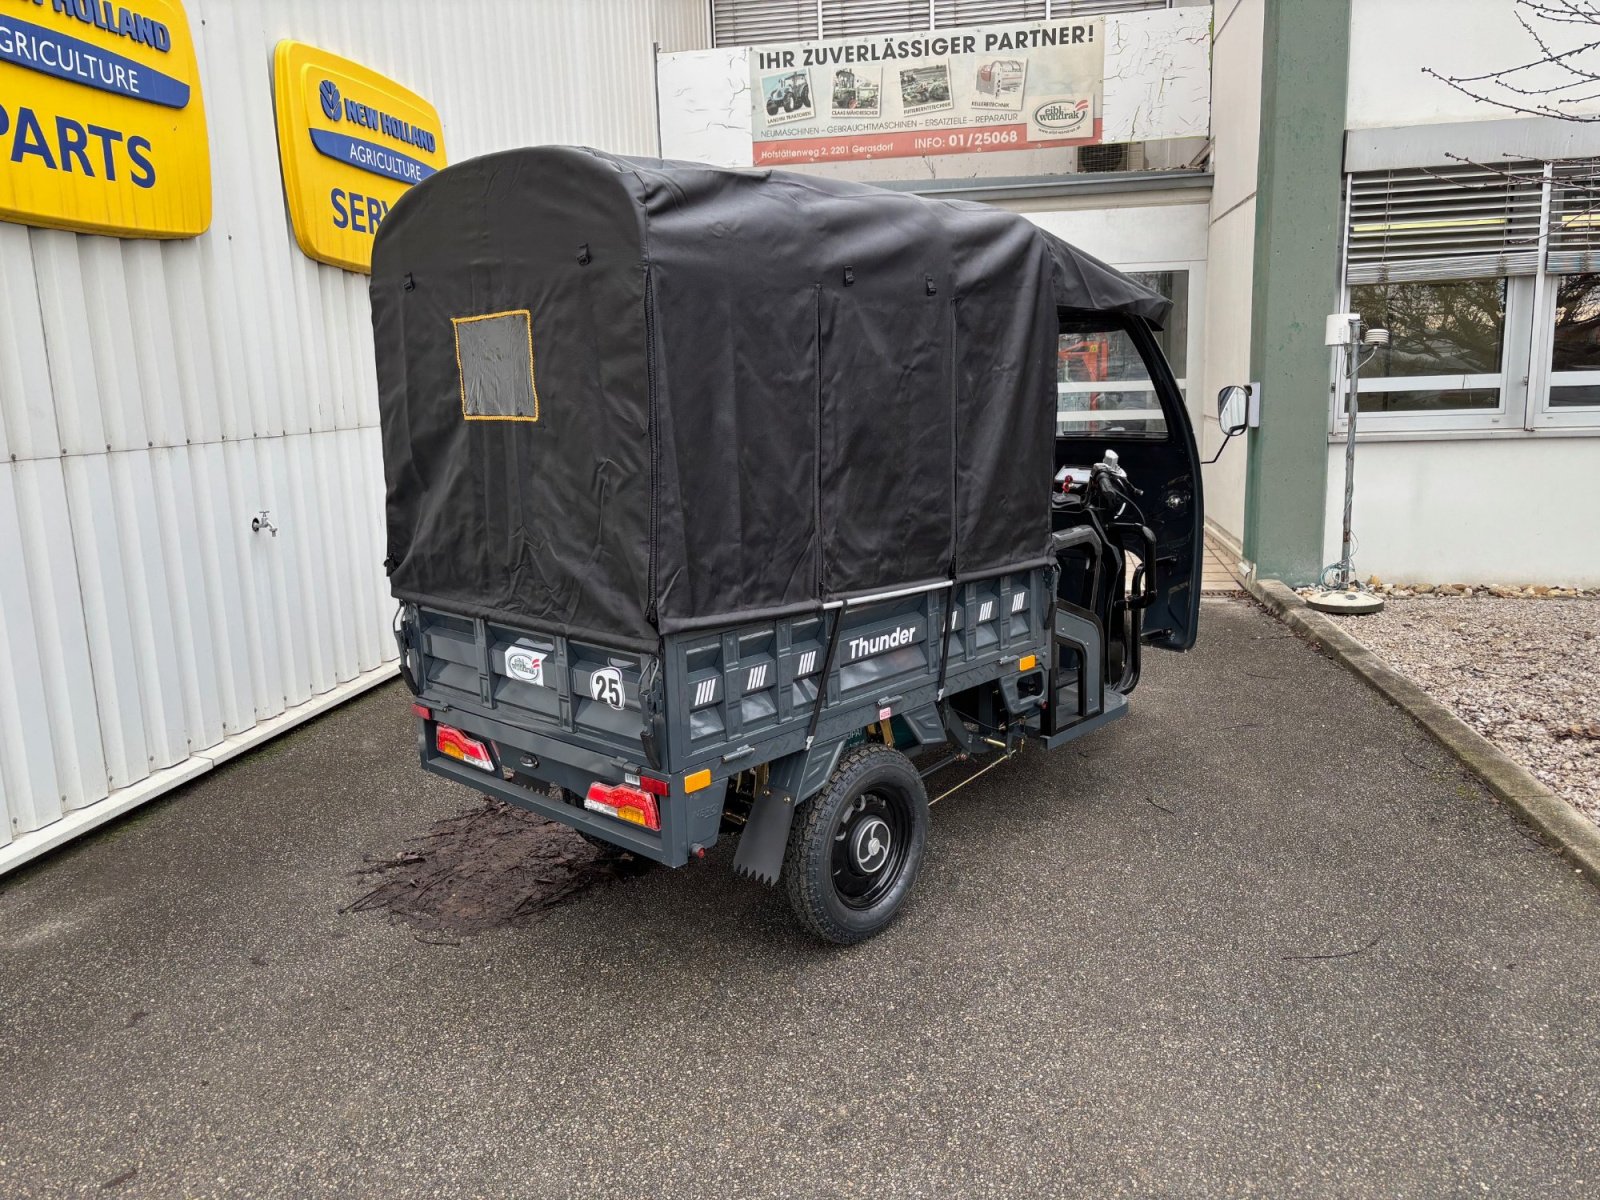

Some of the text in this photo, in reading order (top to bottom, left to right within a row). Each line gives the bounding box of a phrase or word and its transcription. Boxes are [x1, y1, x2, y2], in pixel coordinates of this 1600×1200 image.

[759, 25, 1094, 69] IHR ZUVERLÄSSIGER PARTNER!
[344, 98, 435, 153] NEW HOLLAND
[760, 113, 1018, 138] NEUMASCHINEN GEBRAUCHTMASCHINEN ERSATZTEILE REPARATUR
[914, 130, 1018, 149] INFO: 01/25068
[350, 143, 422, 181] AGRICULTURE
[831, 145, 849, 155] 2201
[851, 142, 894, 153] Gerasdorf
[849, 626, 916, 659] Thunder
[595, 675, 620, 706] 25
